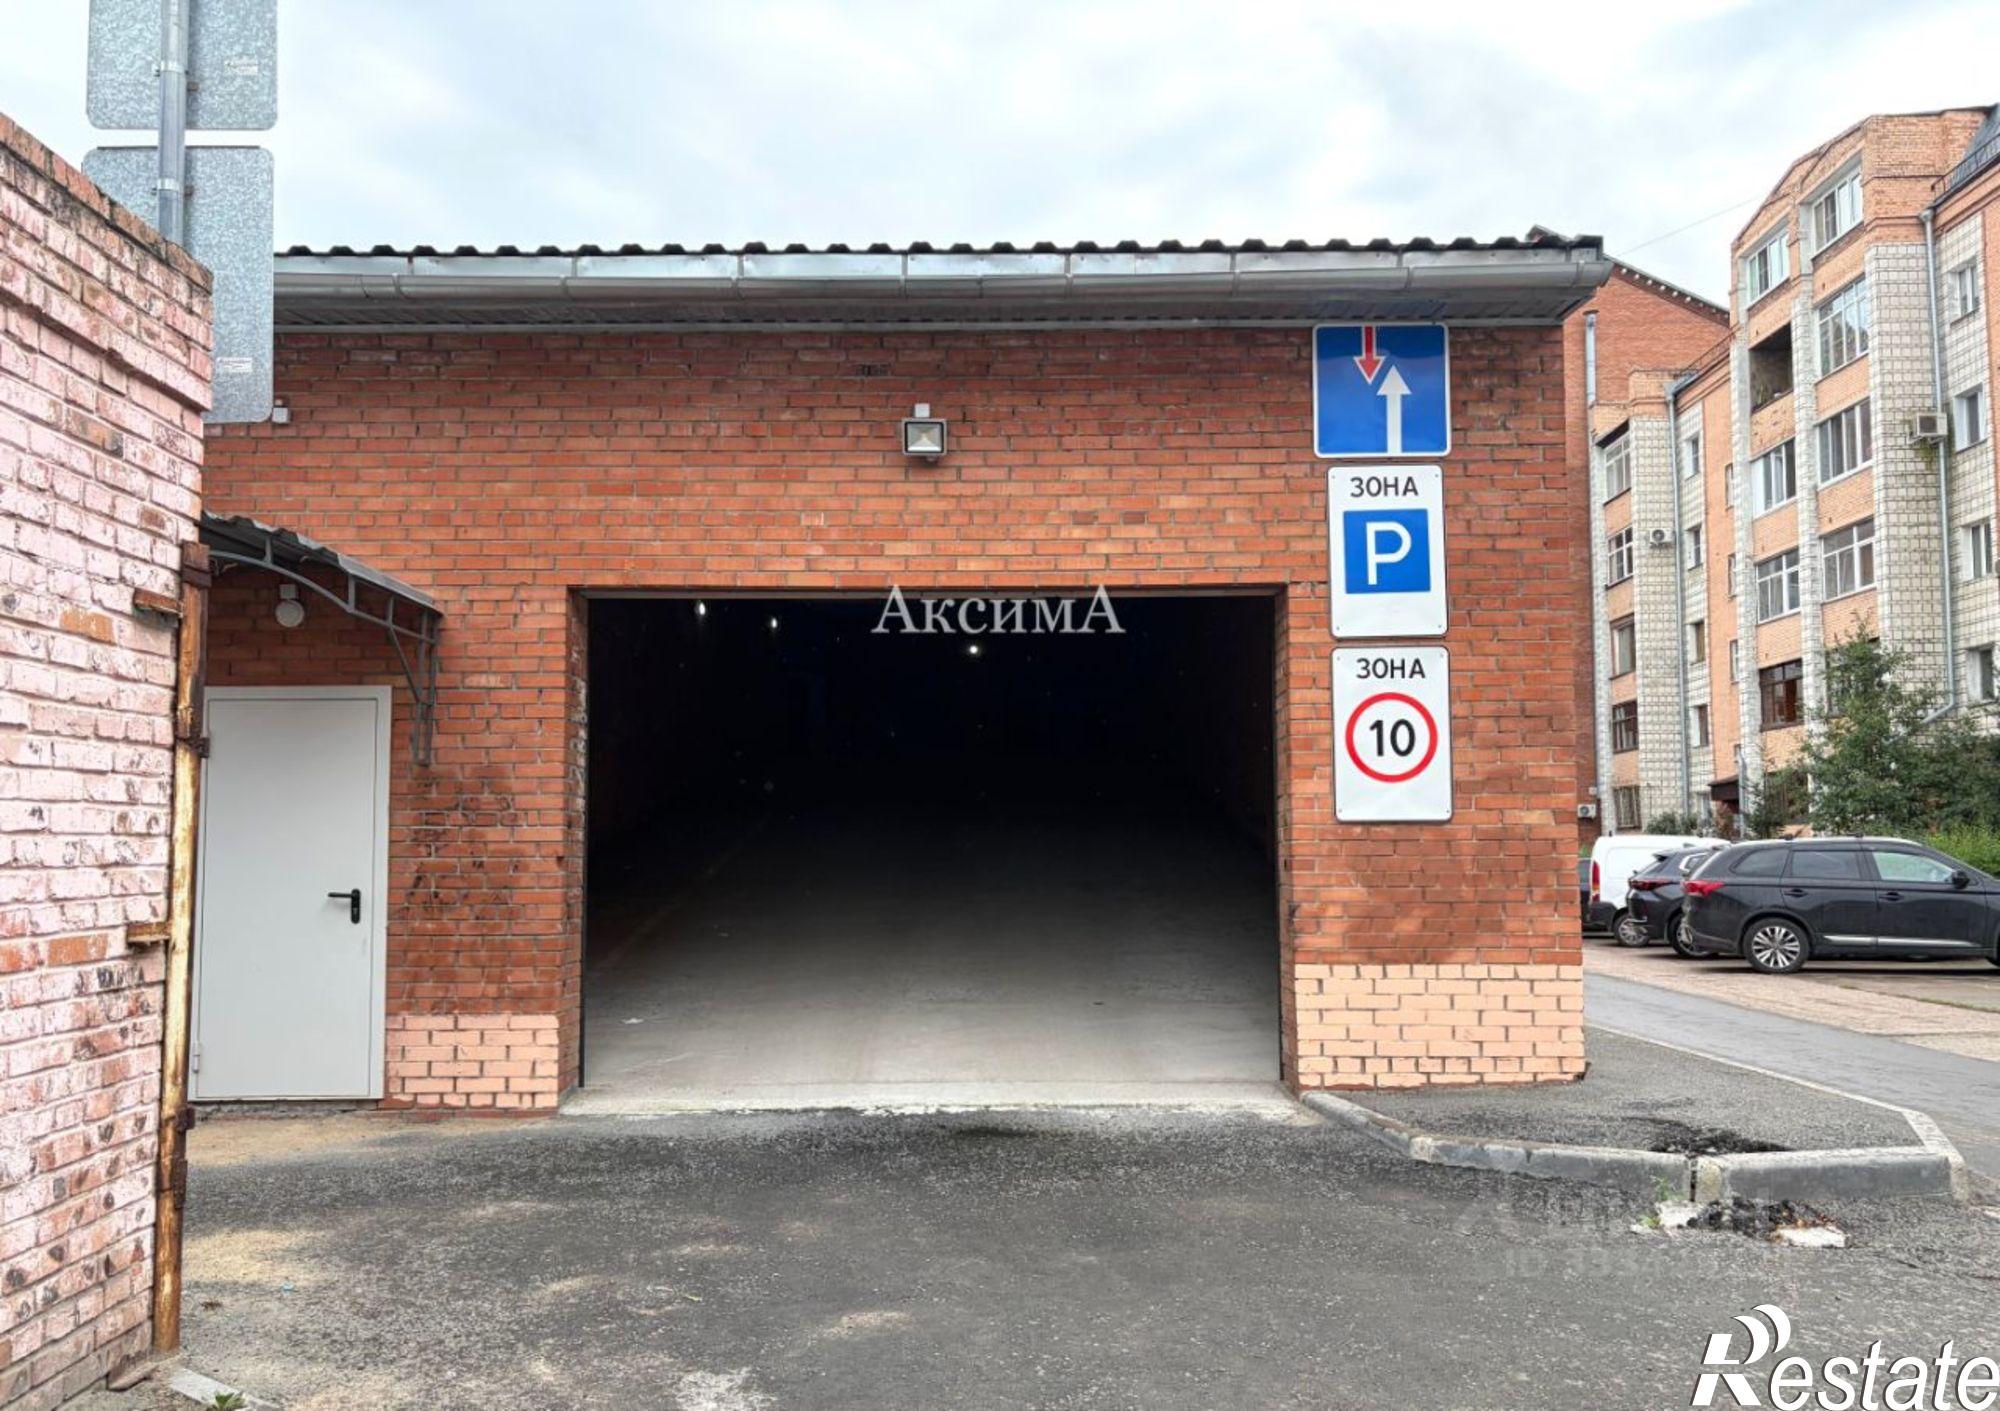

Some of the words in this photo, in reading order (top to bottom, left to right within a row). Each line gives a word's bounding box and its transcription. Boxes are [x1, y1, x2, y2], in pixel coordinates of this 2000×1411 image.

[1350, 476, 1419, 498] ЗОНА
[1366, 521, 1412, 585] P
[1356, 657, 1426, 679] ЗОНА
[1369, 718, 1416, 757] 10
